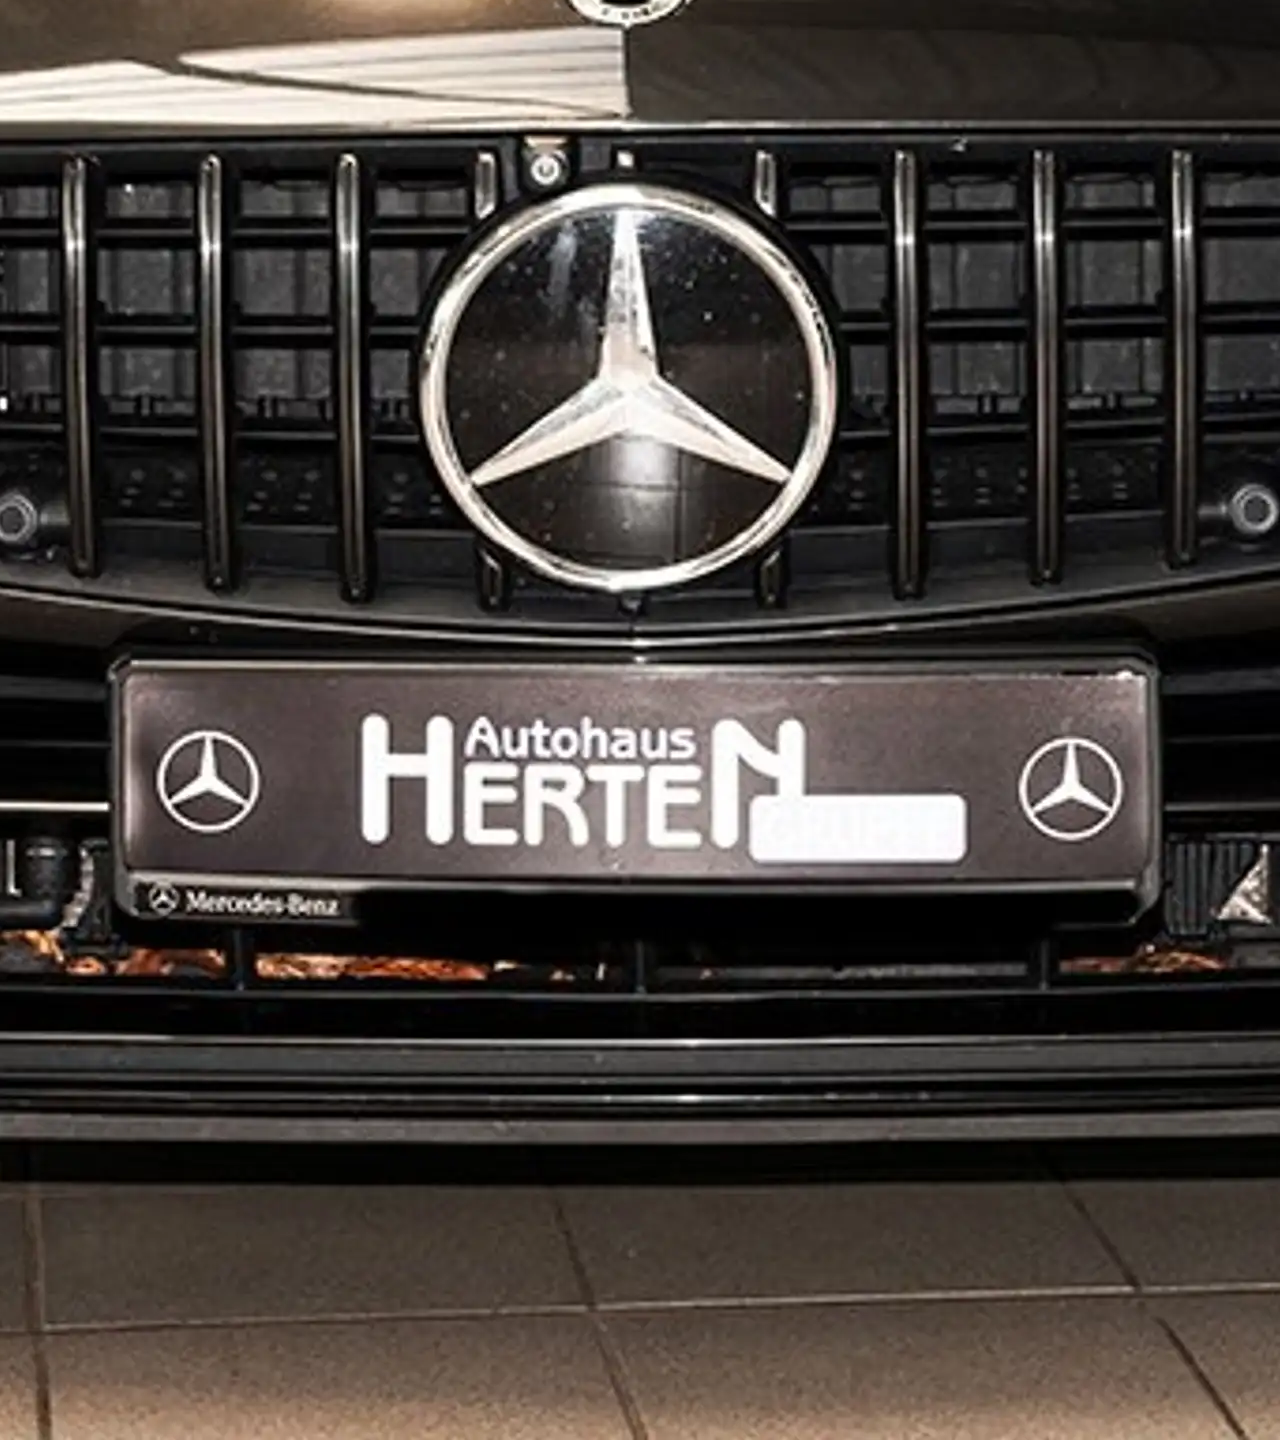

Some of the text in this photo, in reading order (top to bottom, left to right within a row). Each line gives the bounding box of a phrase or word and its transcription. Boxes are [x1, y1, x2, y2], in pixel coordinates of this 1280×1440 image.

[463, 715, 698, 760] Autohaus
[361, 714, 806, 850] HERTEN
[185, 889, 340, 916] Mercedes-Benz
